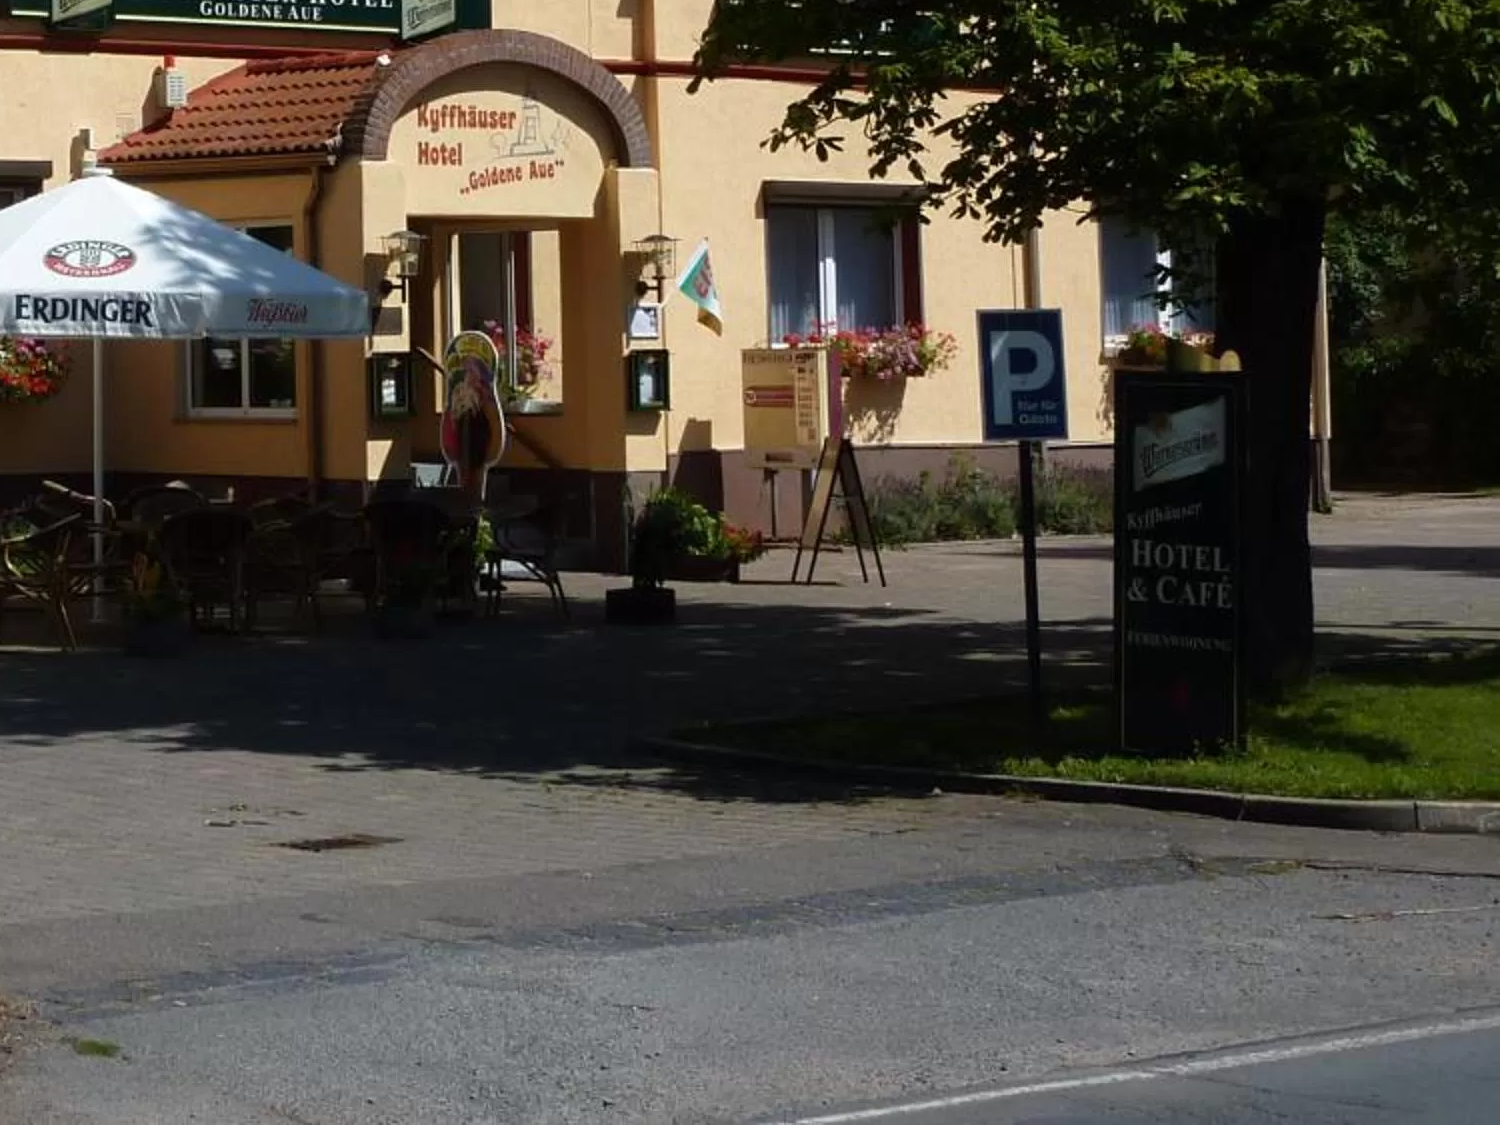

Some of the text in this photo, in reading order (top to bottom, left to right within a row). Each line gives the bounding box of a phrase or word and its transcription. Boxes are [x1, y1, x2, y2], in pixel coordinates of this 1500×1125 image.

[200, 0, 323, 22] GOLDENE AUE
[416, 104, 517, 133] Kyffhäuser
[417, 141, 463, 166] Hotel
[14, 293, 155, 328] ERDINGER
[990, 330, 1055, 424] P
[1131, 539, 1232, 572] HOTEL
[1127, 576, 1233, 608] & CAFÉ
